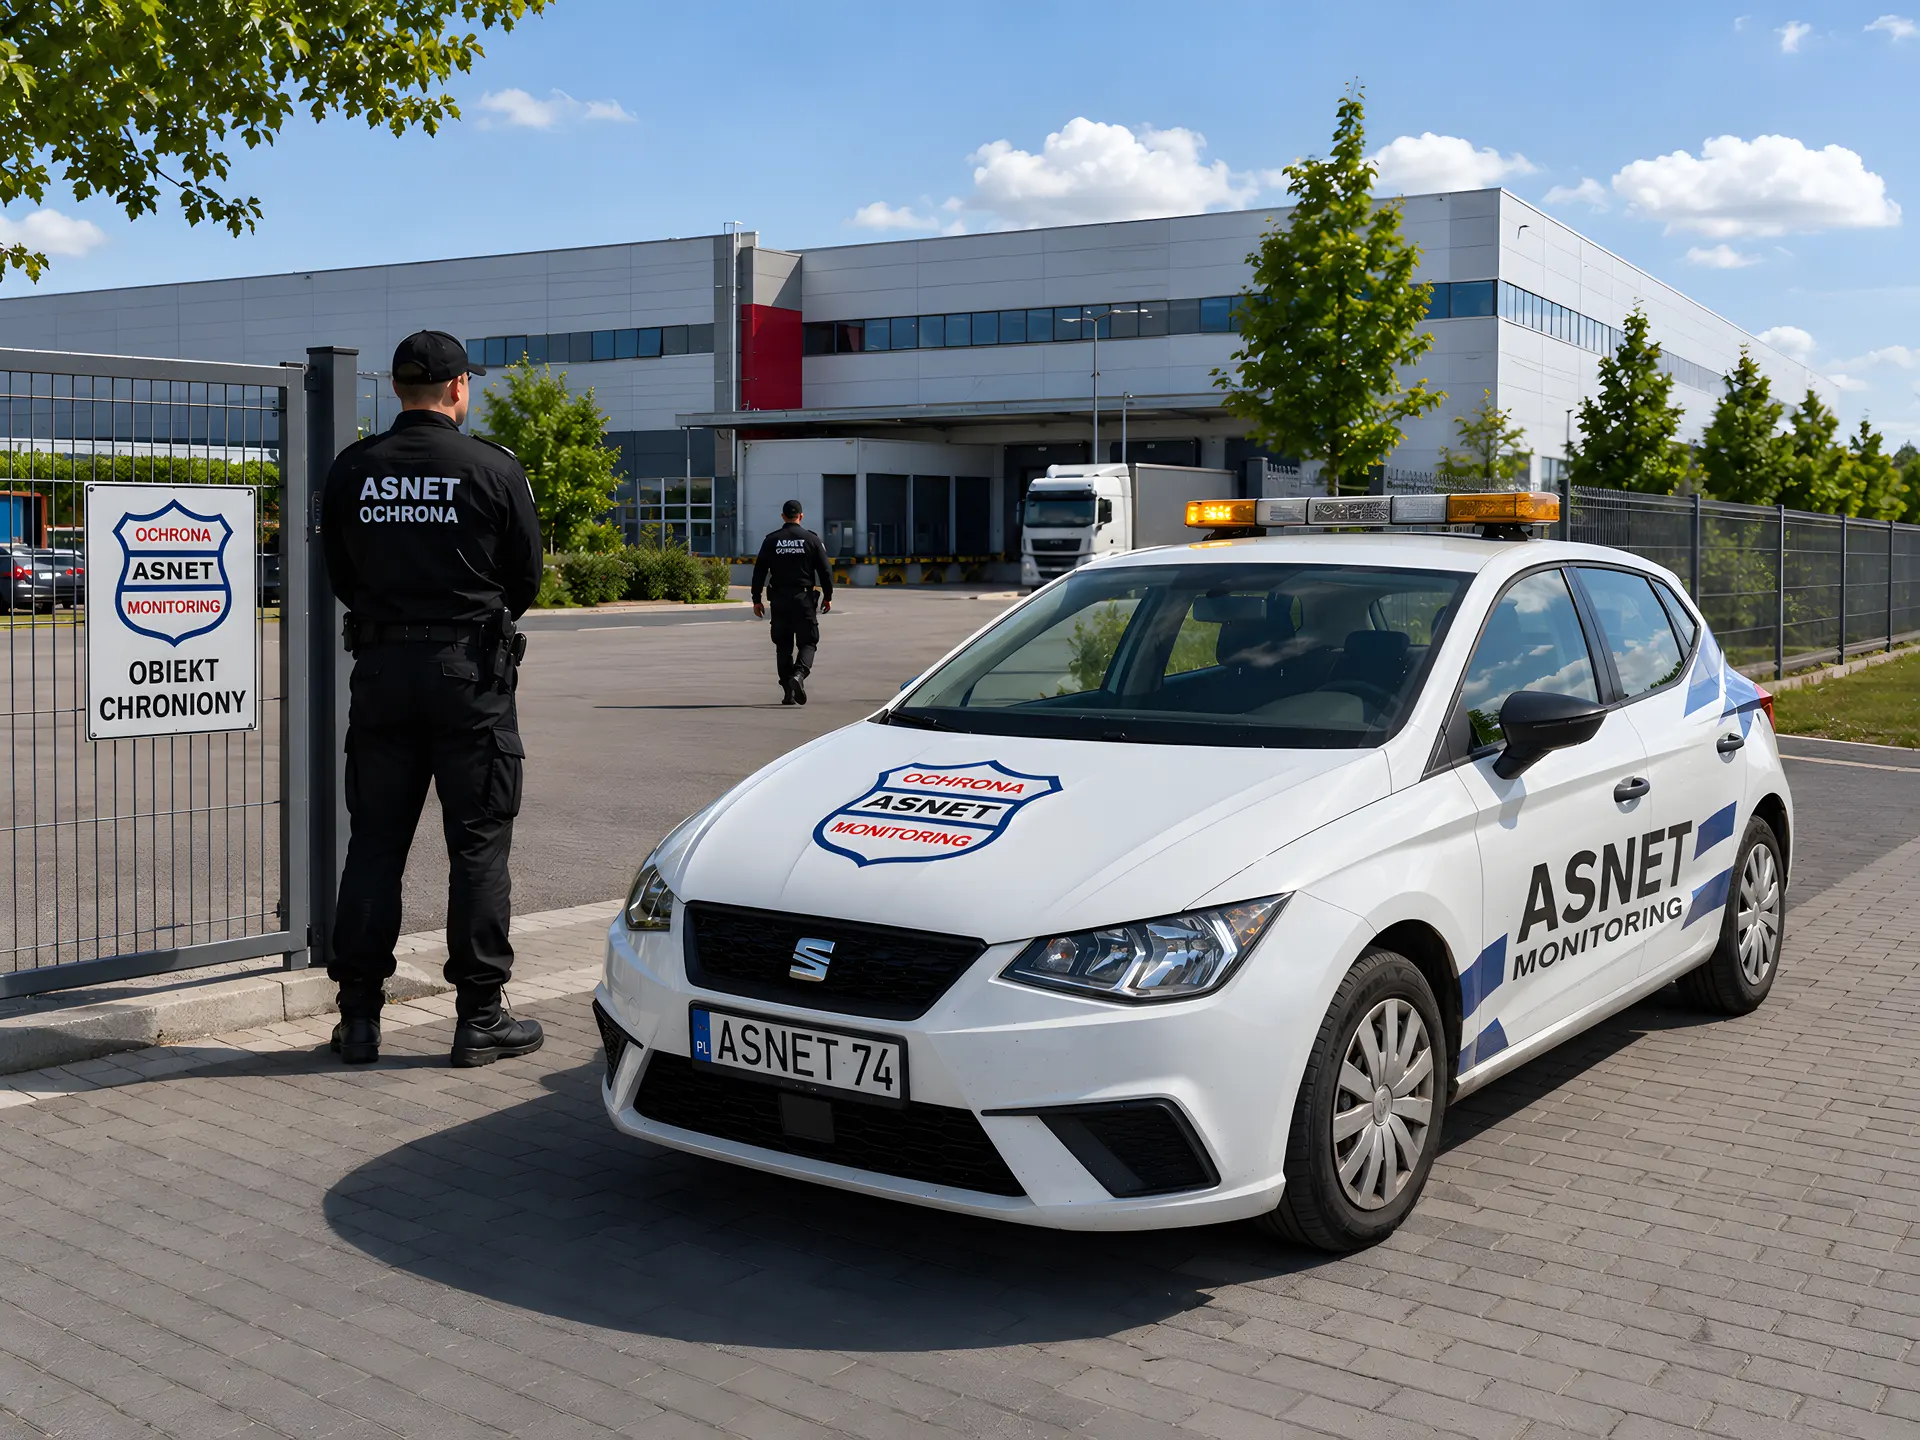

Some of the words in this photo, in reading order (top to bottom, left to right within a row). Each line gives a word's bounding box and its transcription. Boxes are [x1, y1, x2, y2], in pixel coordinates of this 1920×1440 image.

[360, 476, 461, 501] ASNET
[360, 505, 459, 523] OCHRONA
[135, 527, 212, 542] OCHRONA
[132, 561, 214, 580] ASNET
[127, 600, 221, 615] MONITORING
[129, 659, 219, 685] OBIEKT
[99, 690, 247, 721] CHRONIONY
[903, 773, 1024, 794] OCHRONA
[862, 795, 1002, 819] ASNET
[829, 821, 972, 847] MONITORING
[1516, 820, 1693, 945] ASNET
[1512, 897, 1683, 981] MONITORING
[696, 1040, 709, 1055] PL
[717, 1020, 839, 1081] ASNET
[852, 1043, 893, 1091] 74
